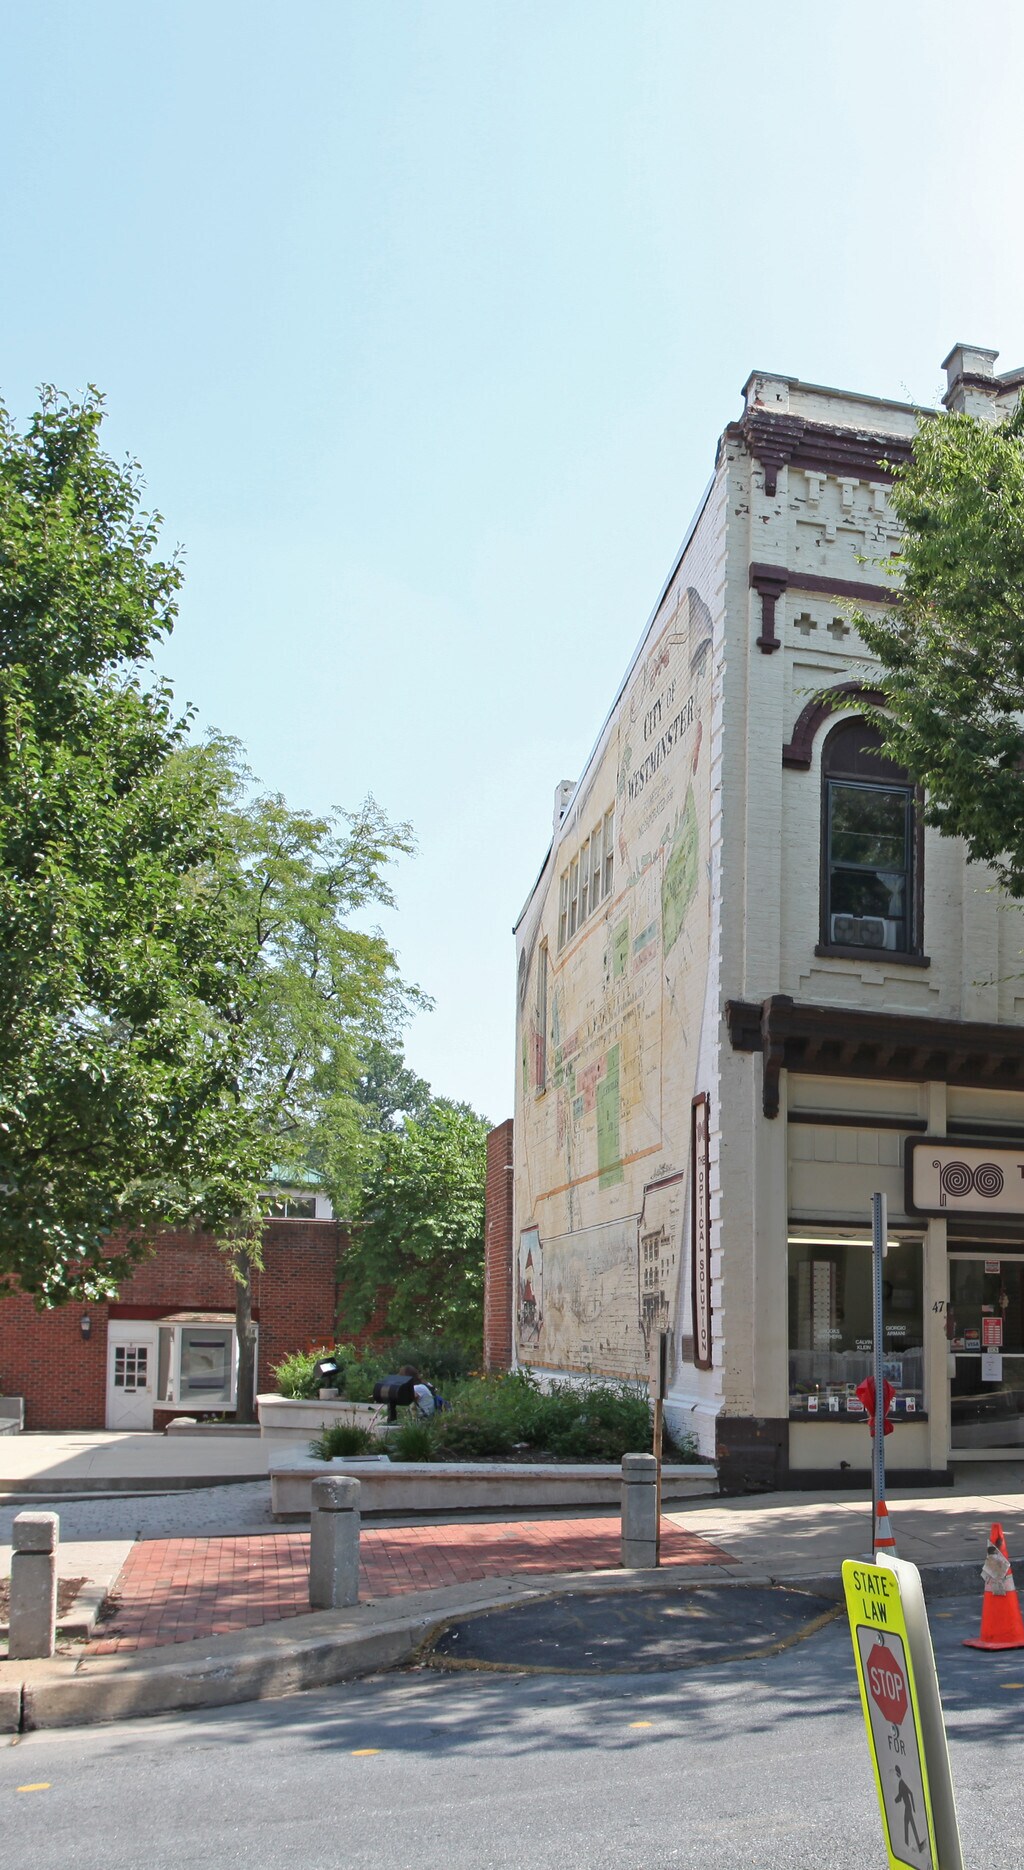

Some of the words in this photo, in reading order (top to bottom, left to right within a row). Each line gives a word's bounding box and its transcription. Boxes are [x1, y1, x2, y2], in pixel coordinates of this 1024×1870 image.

[643, 694, 664, 742] CITY
[627, 695, 694, 803] WESTMINSTER
[699, 1260, 707, 1351] SOLUTION
[932, 1301, 944, 1314] 47
[853, 1571, 890, 1598] STATE
[862, 1598, 888, 1624] LAW
[871, 1667, 903, 1702] STOP
[887, 1735, 906, 1757] FOR
